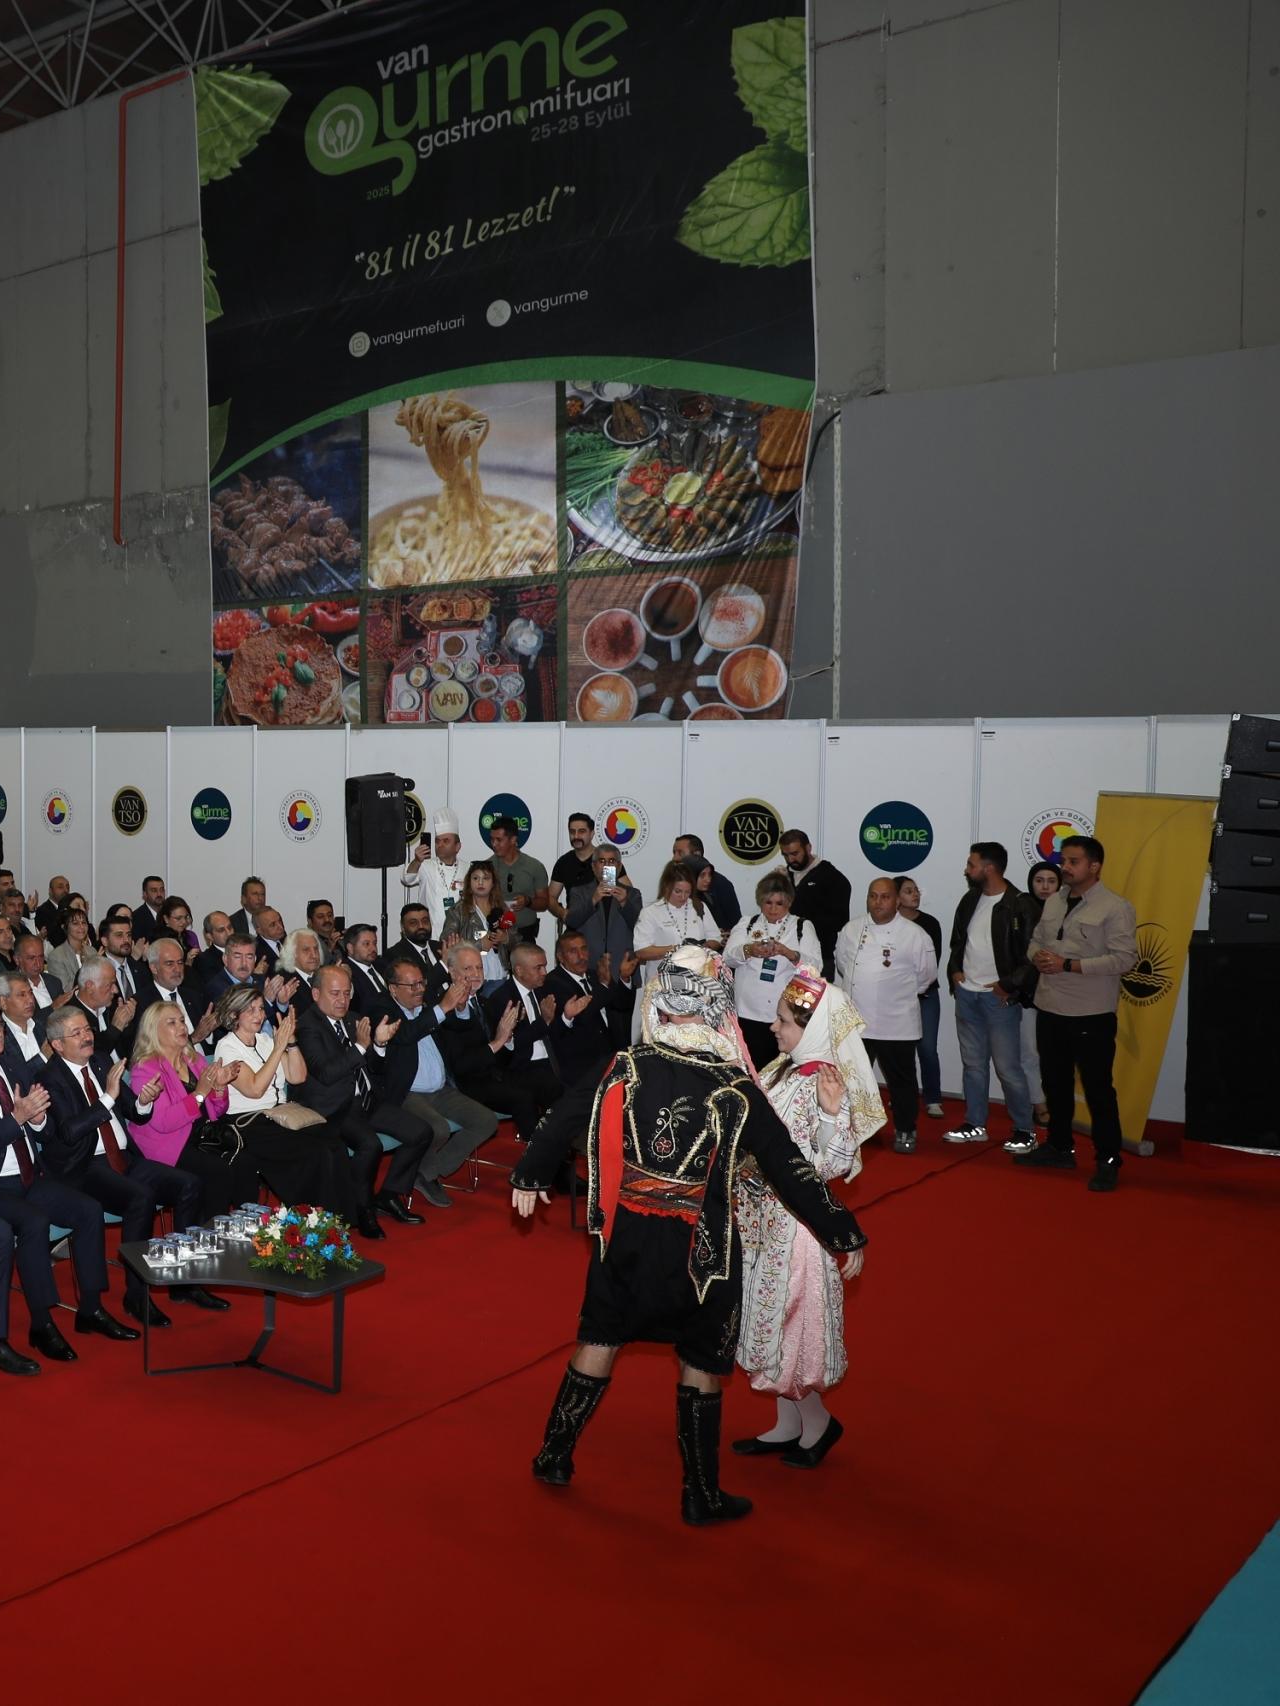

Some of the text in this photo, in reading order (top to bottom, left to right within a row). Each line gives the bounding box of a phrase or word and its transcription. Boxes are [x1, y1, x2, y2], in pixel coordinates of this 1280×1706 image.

[376, 43, 430, 80] van
[531, 101, 632, 142] 25-28 Eylül
[366, 185, 390, 200] 2025
[423, 224, 456, 261] 81
[513, 289, 589, 315] vangurme
[372, 315, 465, 347] vangurmefuari
[119, 799, 140, 810] VAN
[118, 810, 141, 823] TSO
[733, 816, 770, 831] VAN
[1026, 813, 1051, 836] ODALAR
[731, 831, 772, 848] TSO
